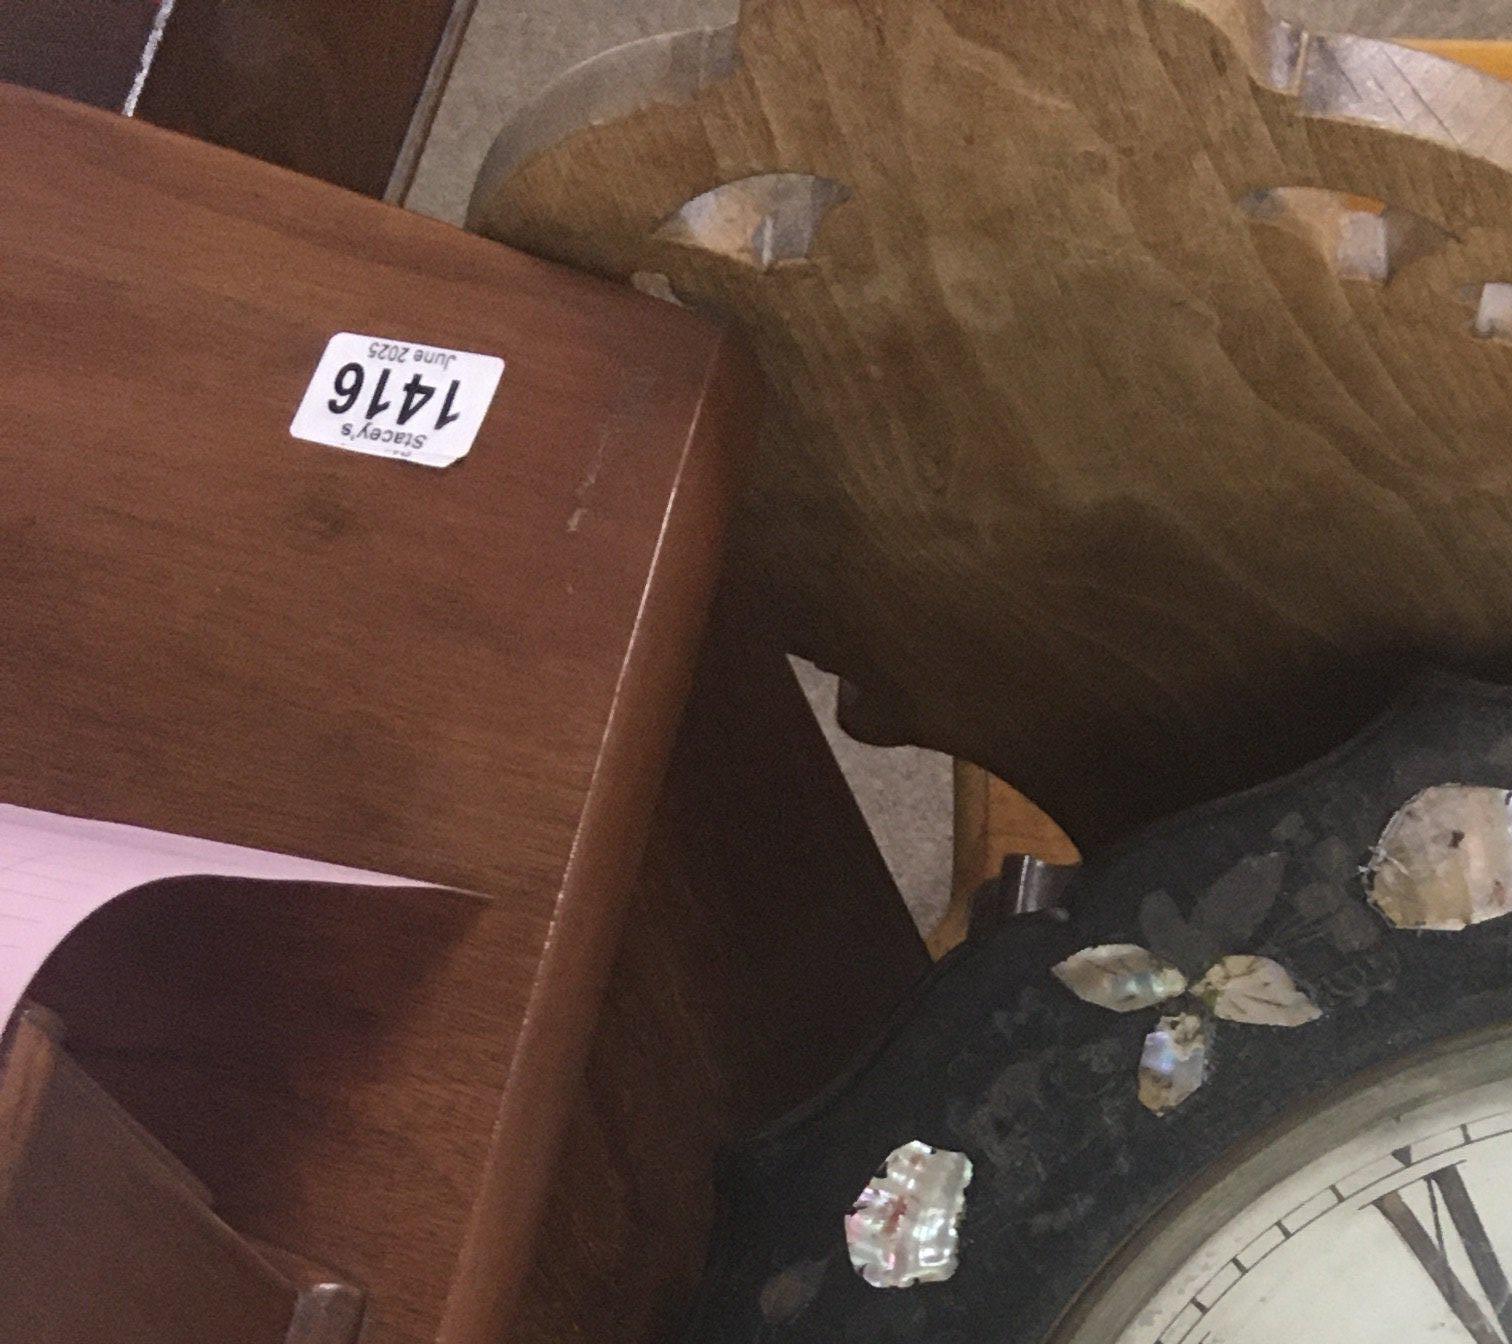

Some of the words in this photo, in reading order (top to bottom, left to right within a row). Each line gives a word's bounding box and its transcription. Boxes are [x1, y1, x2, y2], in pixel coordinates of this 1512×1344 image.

[368, 341, 410, 363] 2025
[413, 350, 457, 371] June
[328, 362, 461, 430] 1416
[341, 422, 427, 449] Stacey's
